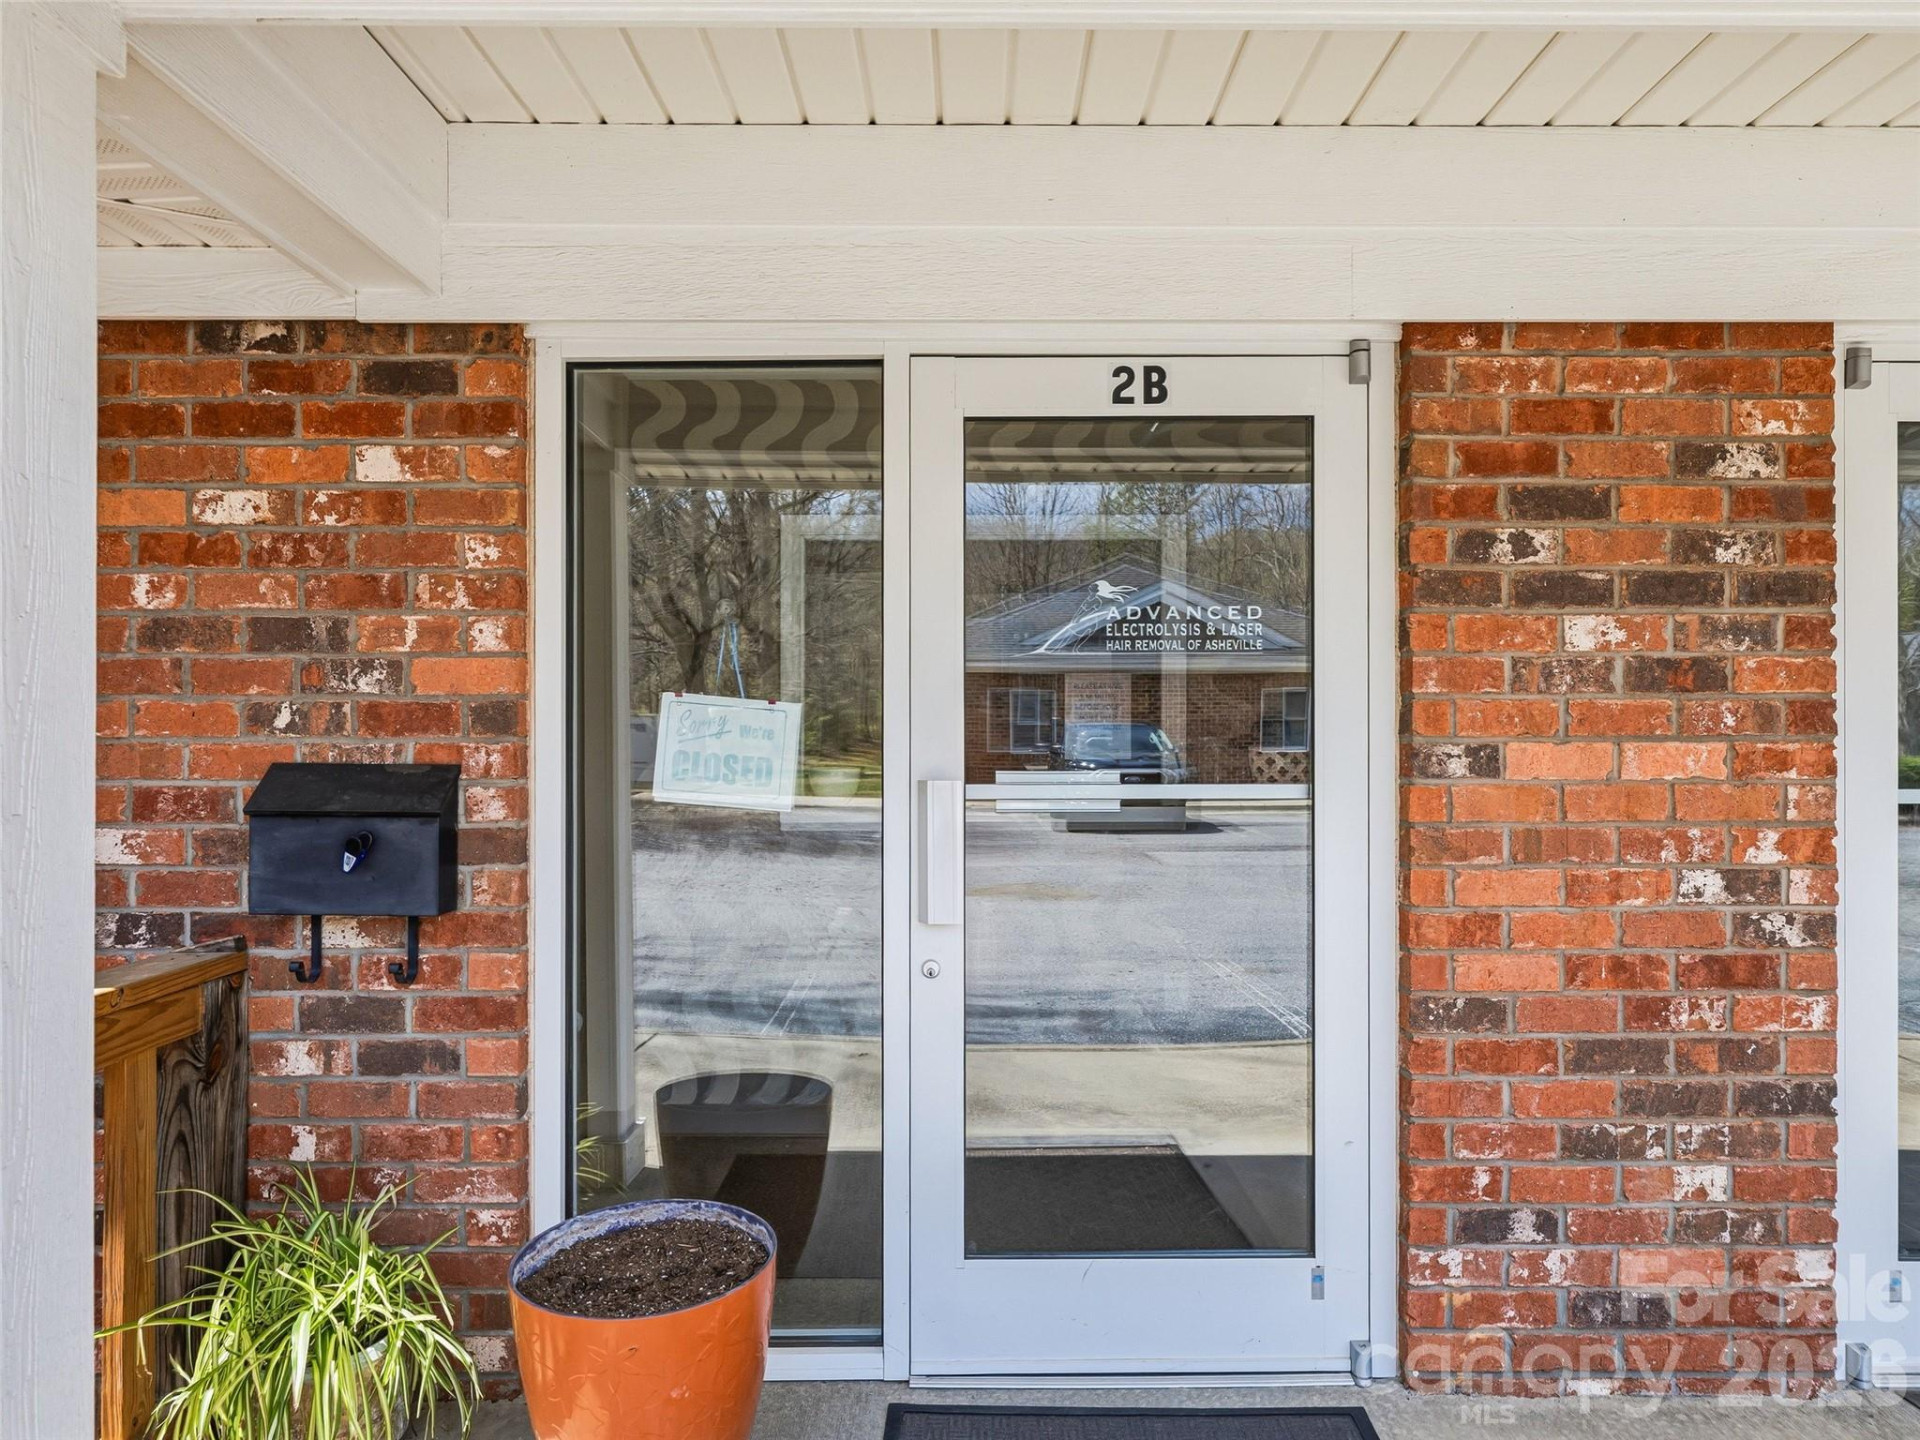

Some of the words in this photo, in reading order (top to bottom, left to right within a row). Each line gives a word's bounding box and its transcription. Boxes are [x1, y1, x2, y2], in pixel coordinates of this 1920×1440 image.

[1112, 365, 1168, 404] 2B
[1106, 606, 1262, 620] ADVANCED
[1106, 623, 1200, 636] ELECTROLYSIS
[1206, 622, 1215, 636] &
[1222, 623, 1262, 636] LASER
[1106, 640, 1131, 650] HAIR
[1135, 640, 1184, 650] REMOVAL
[1188, 640, 1200, 650] OF
[1205, 640, 1262, 650] ASHEVILLE
[676, 709, 732, 743] Sorry
[739, 724, 775, 741] We're
[671, 750, 774, 788] CLOSED
